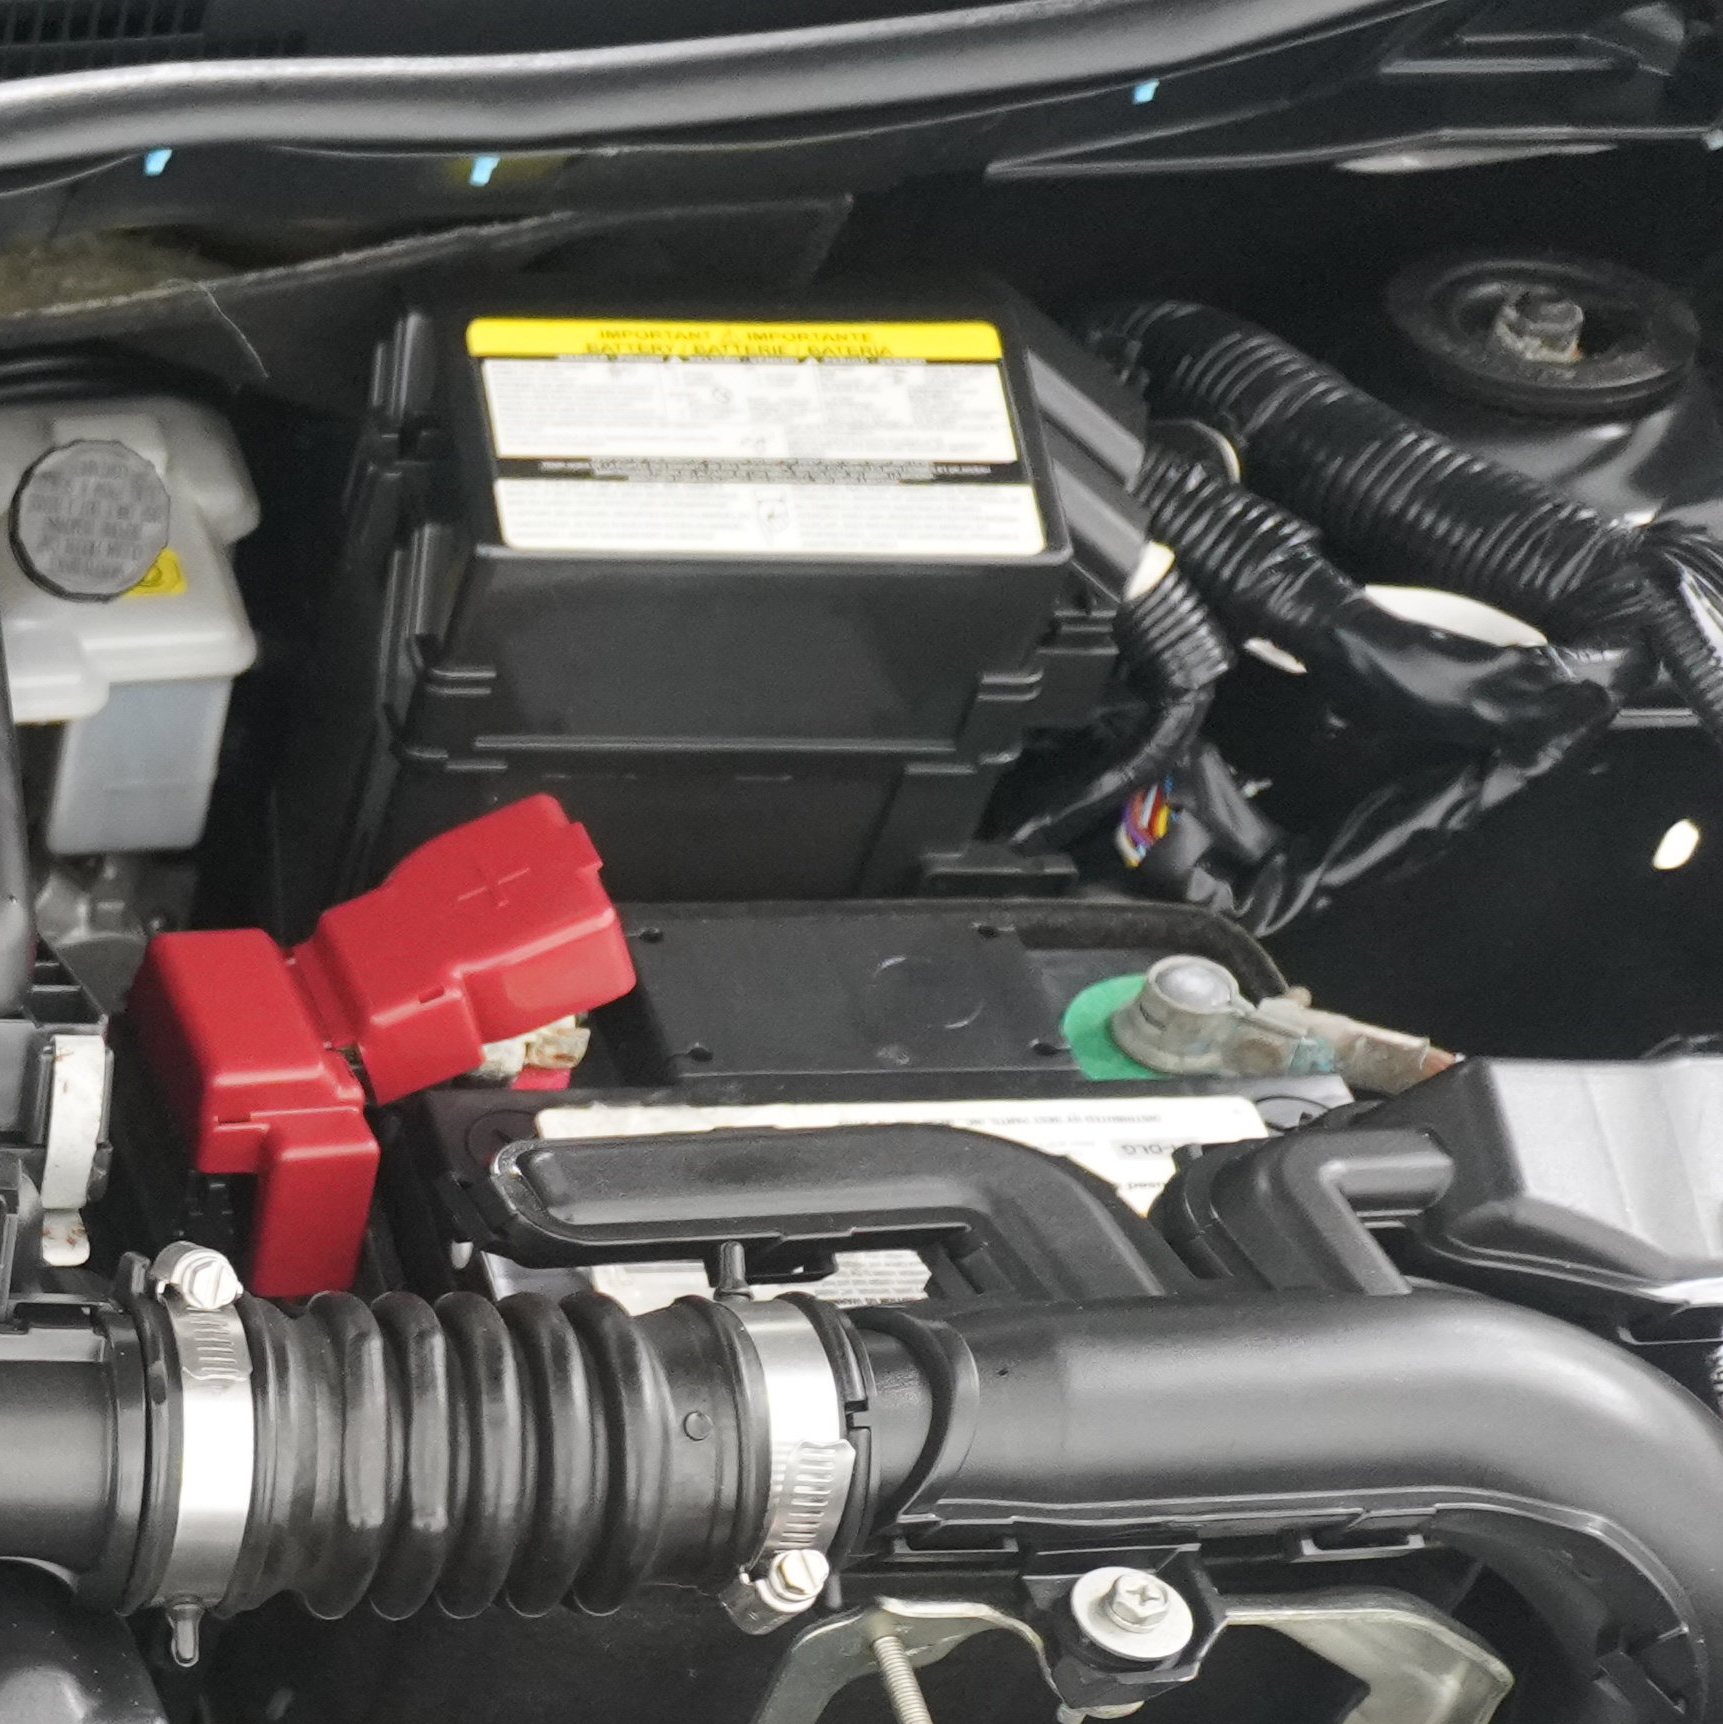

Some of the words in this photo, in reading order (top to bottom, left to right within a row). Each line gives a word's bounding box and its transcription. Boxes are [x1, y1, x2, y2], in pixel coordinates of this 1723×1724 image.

[599, 329, 712, 341] IMPORTANT
[747, 331, 871, 343] IMPORTANTE
[586, 341, 675, 355] BATTERY
[693, 343, 784, 356] BATTERIE
